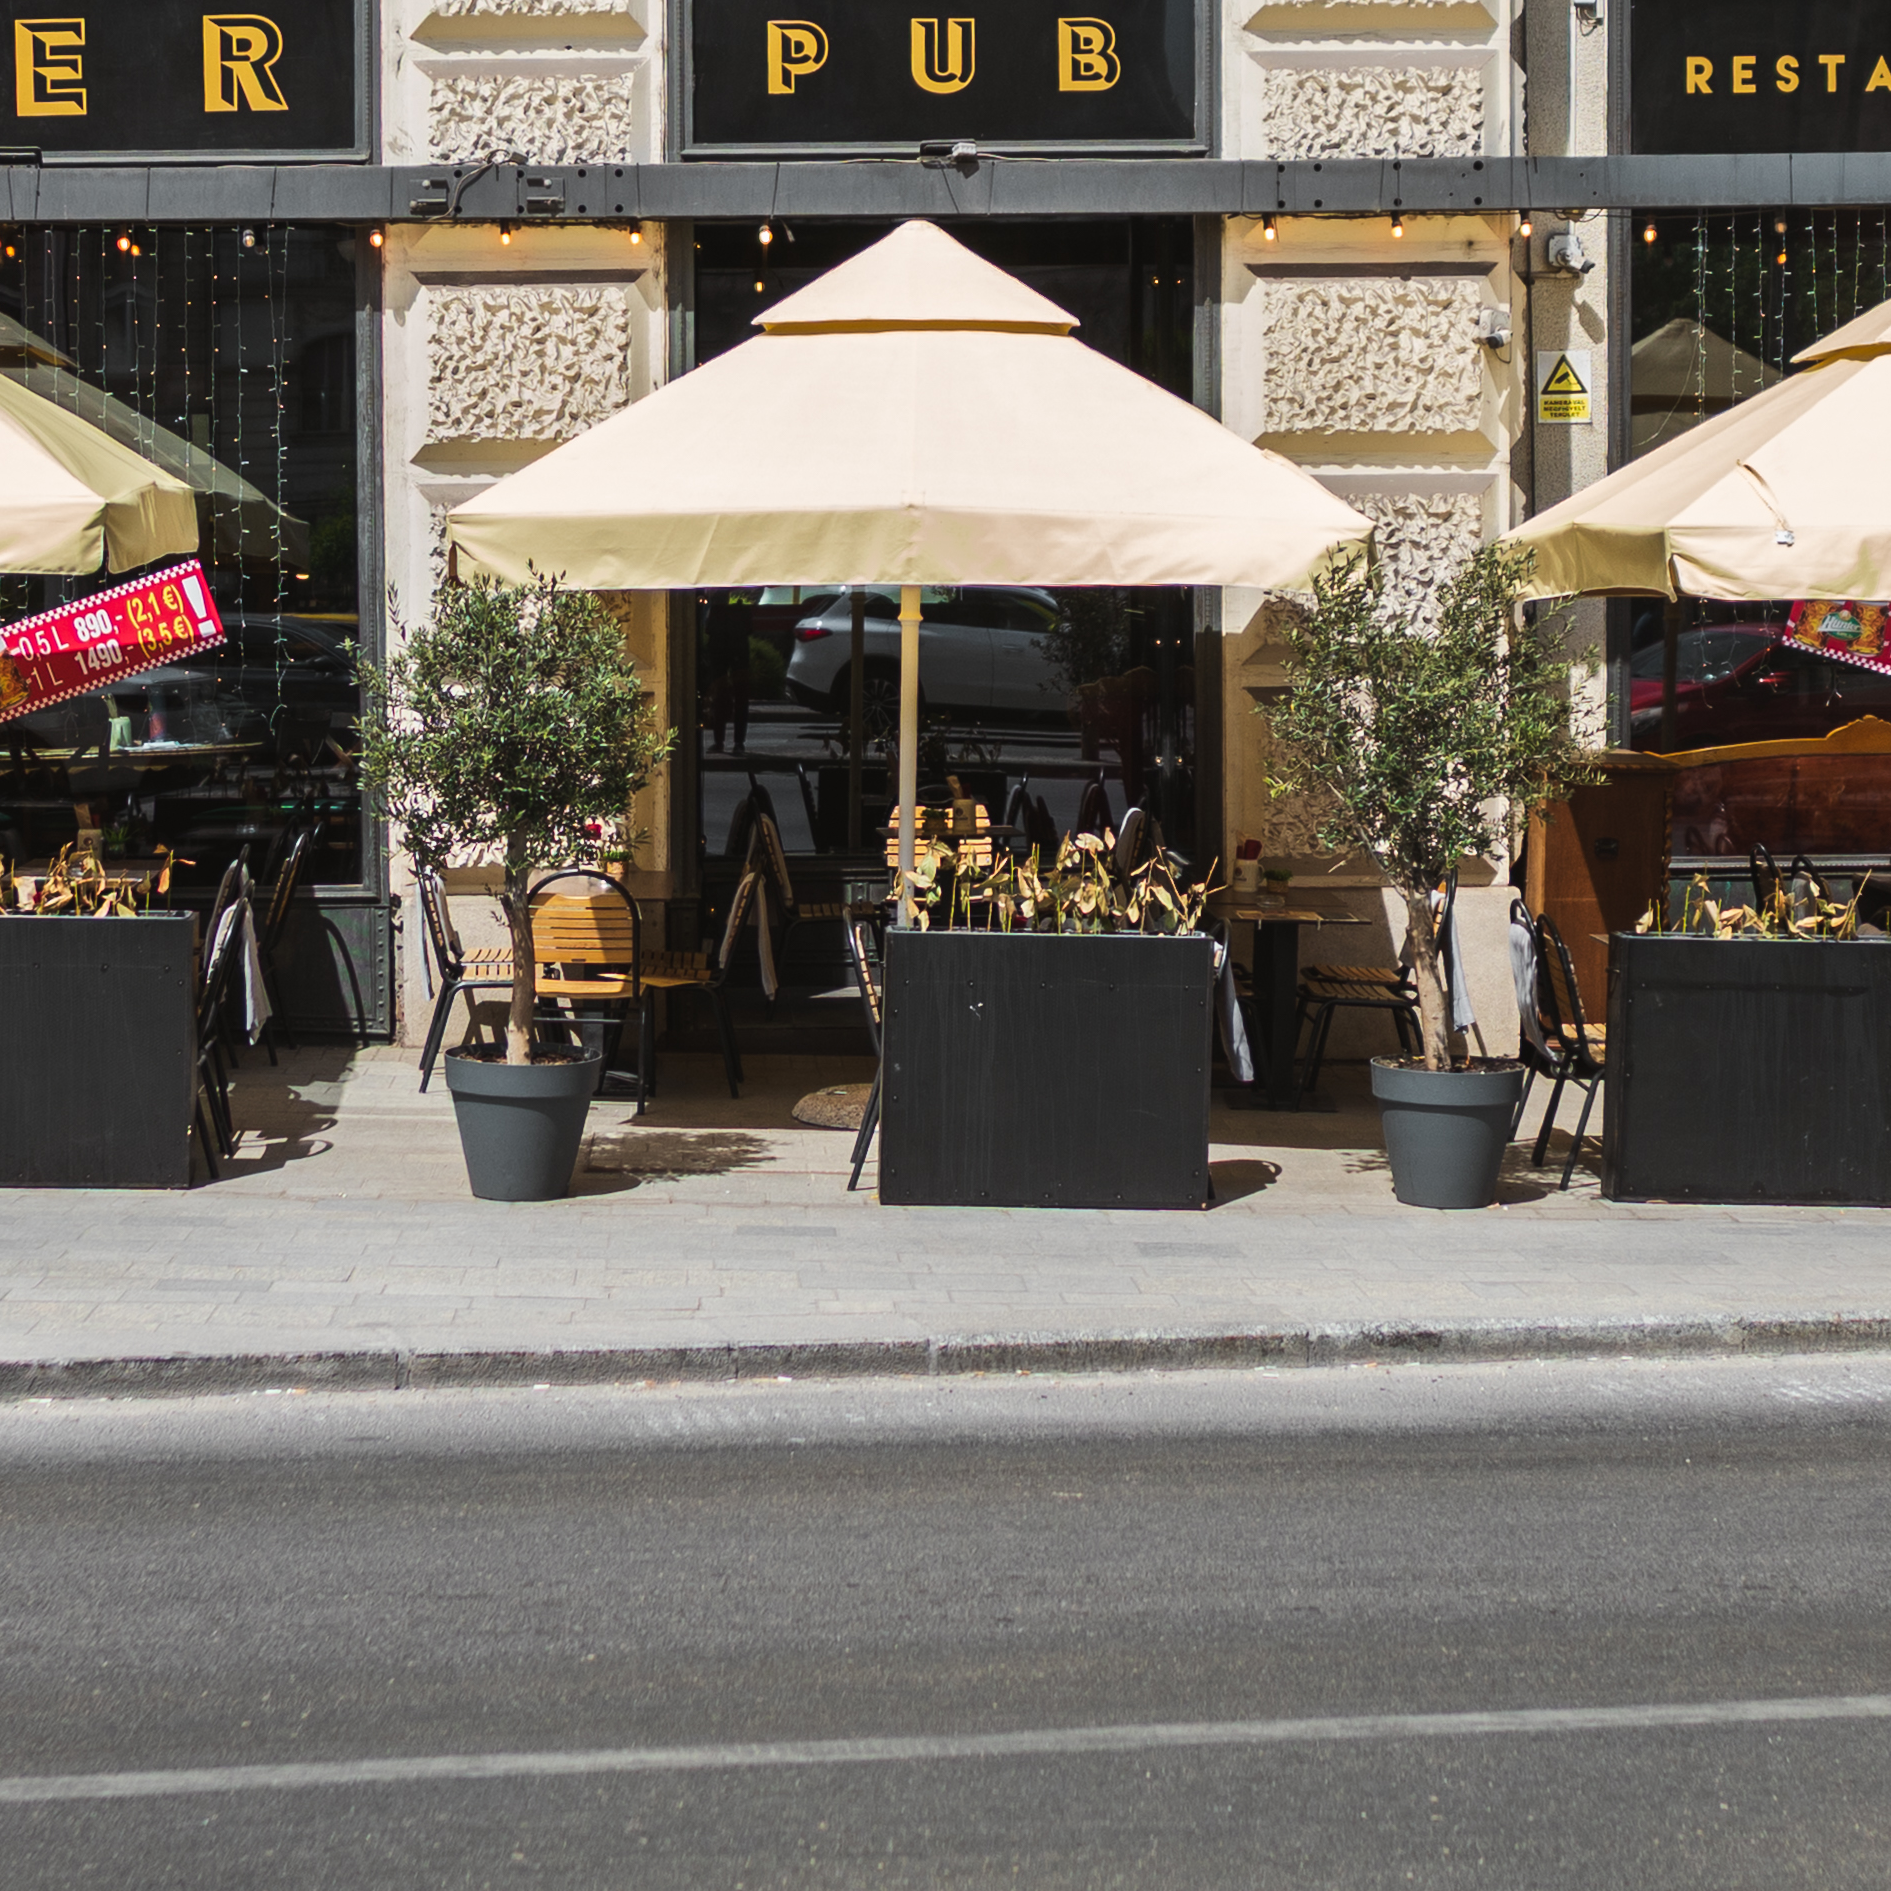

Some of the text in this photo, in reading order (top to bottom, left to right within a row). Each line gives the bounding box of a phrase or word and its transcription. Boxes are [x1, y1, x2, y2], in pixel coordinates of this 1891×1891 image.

[766, 16, 1122, 95] PUB
[52, 625, 70, 650] L
[46, 662, 64, 687] L
